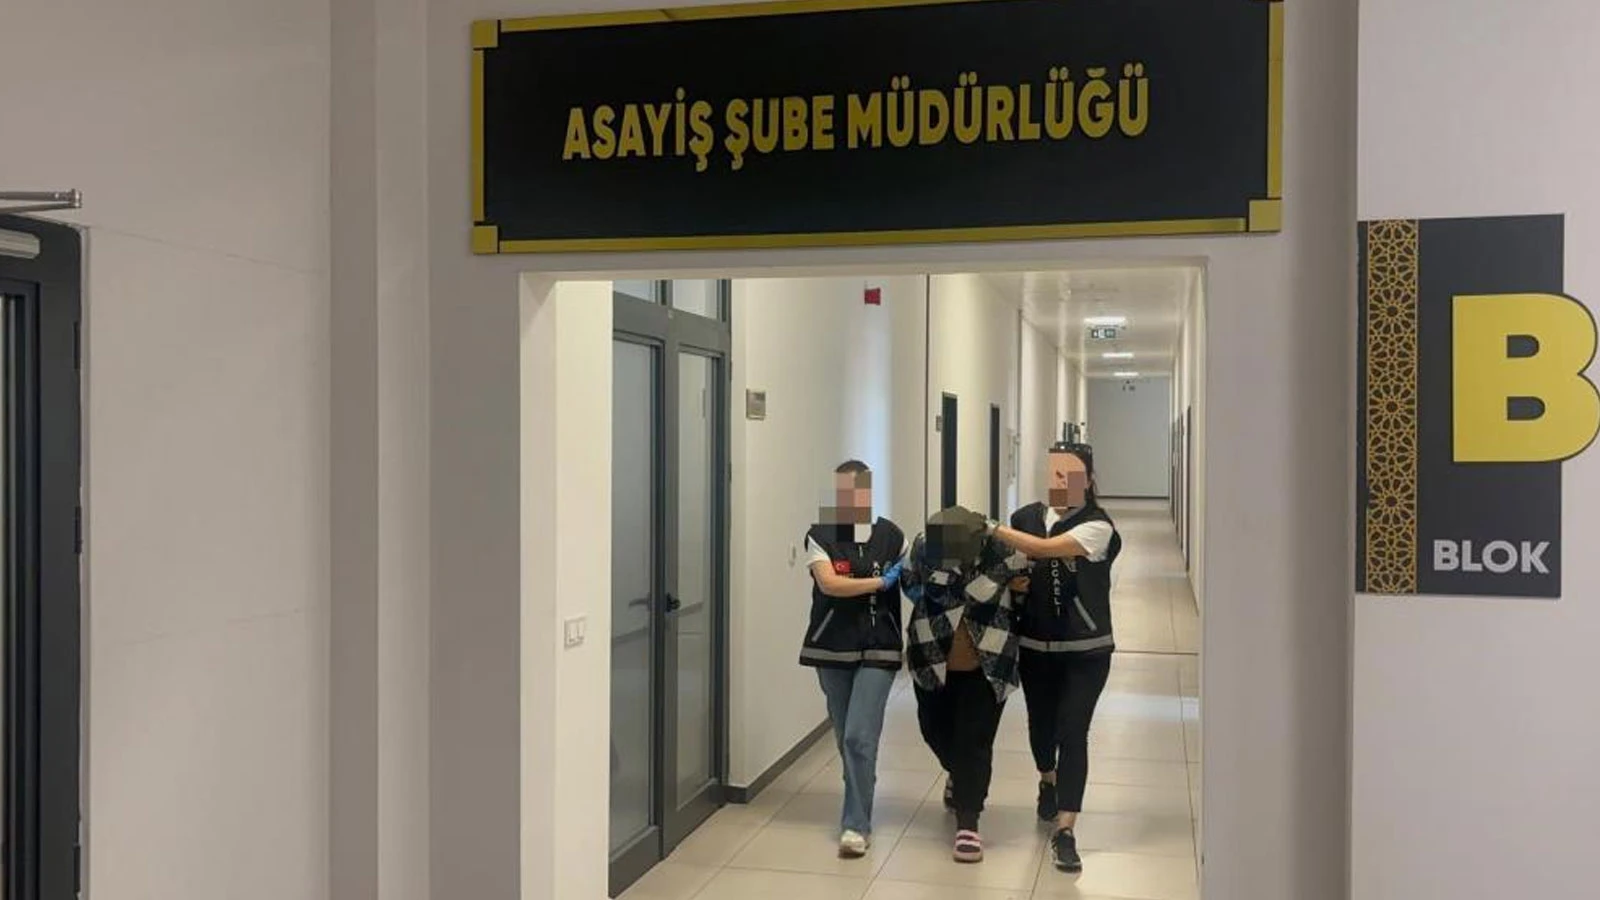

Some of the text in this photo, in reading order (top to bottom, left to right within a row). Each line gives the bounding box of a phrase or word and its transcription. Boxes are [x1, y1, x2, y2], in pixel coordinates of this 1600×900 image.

[563, 63, 1149, 171] ASAYİŞ ŞUBE MÜDÜRLÜĞÜ
[1451, 293, 1600, 463] B
[1050, 559, 1062, 617] OCAELI
[1433, 538, 1550, 574] BLOK
